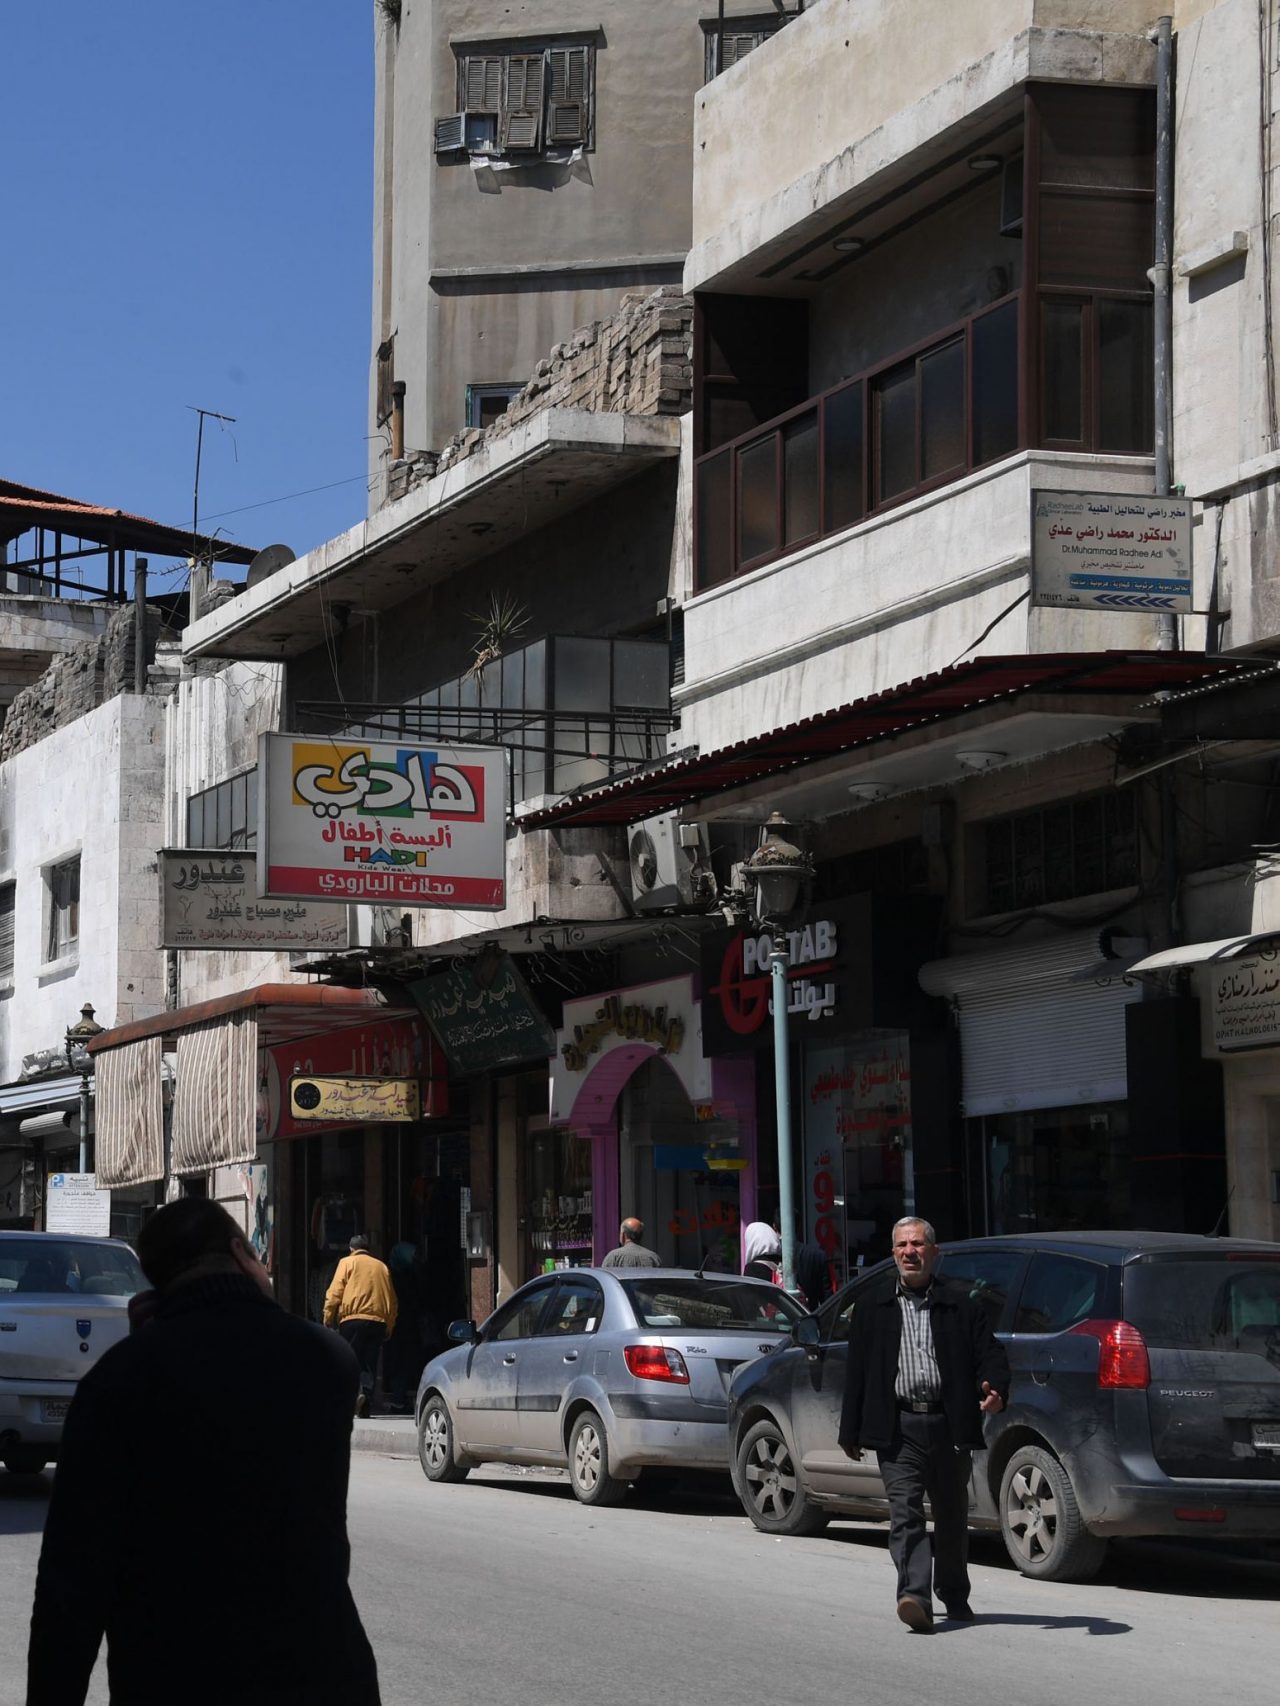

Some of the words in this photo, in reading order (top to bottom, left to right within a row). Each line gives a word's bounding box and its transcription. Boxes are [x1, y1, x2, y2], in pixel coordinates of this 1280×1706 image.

[1087, 502, 1113, 515] الطبية
[1114, 505, 1145, 517] للتحاليل
[1076, 525, 1104, 542] راضي
[1107, 526, 1135, 540] محمد
[1137, 527, 1177, 543] الدكتور
[1119, 547, 1150, 559] Radhee
[1151, 548, 1164, 560] Adi
[293, 751, 477, 819] هادي
[321, 819, 383, 845] أطفال
[390, 825, 452, 853] ألبسة
[343, 846, 427, 868] HADI
[318, 872, 397, 893] البارودي
[399, 875, 455, 896] محلات
[743, 919, 838, 976] POTAB
[1160, 1389, 1216, 1399] PEUGEOT
